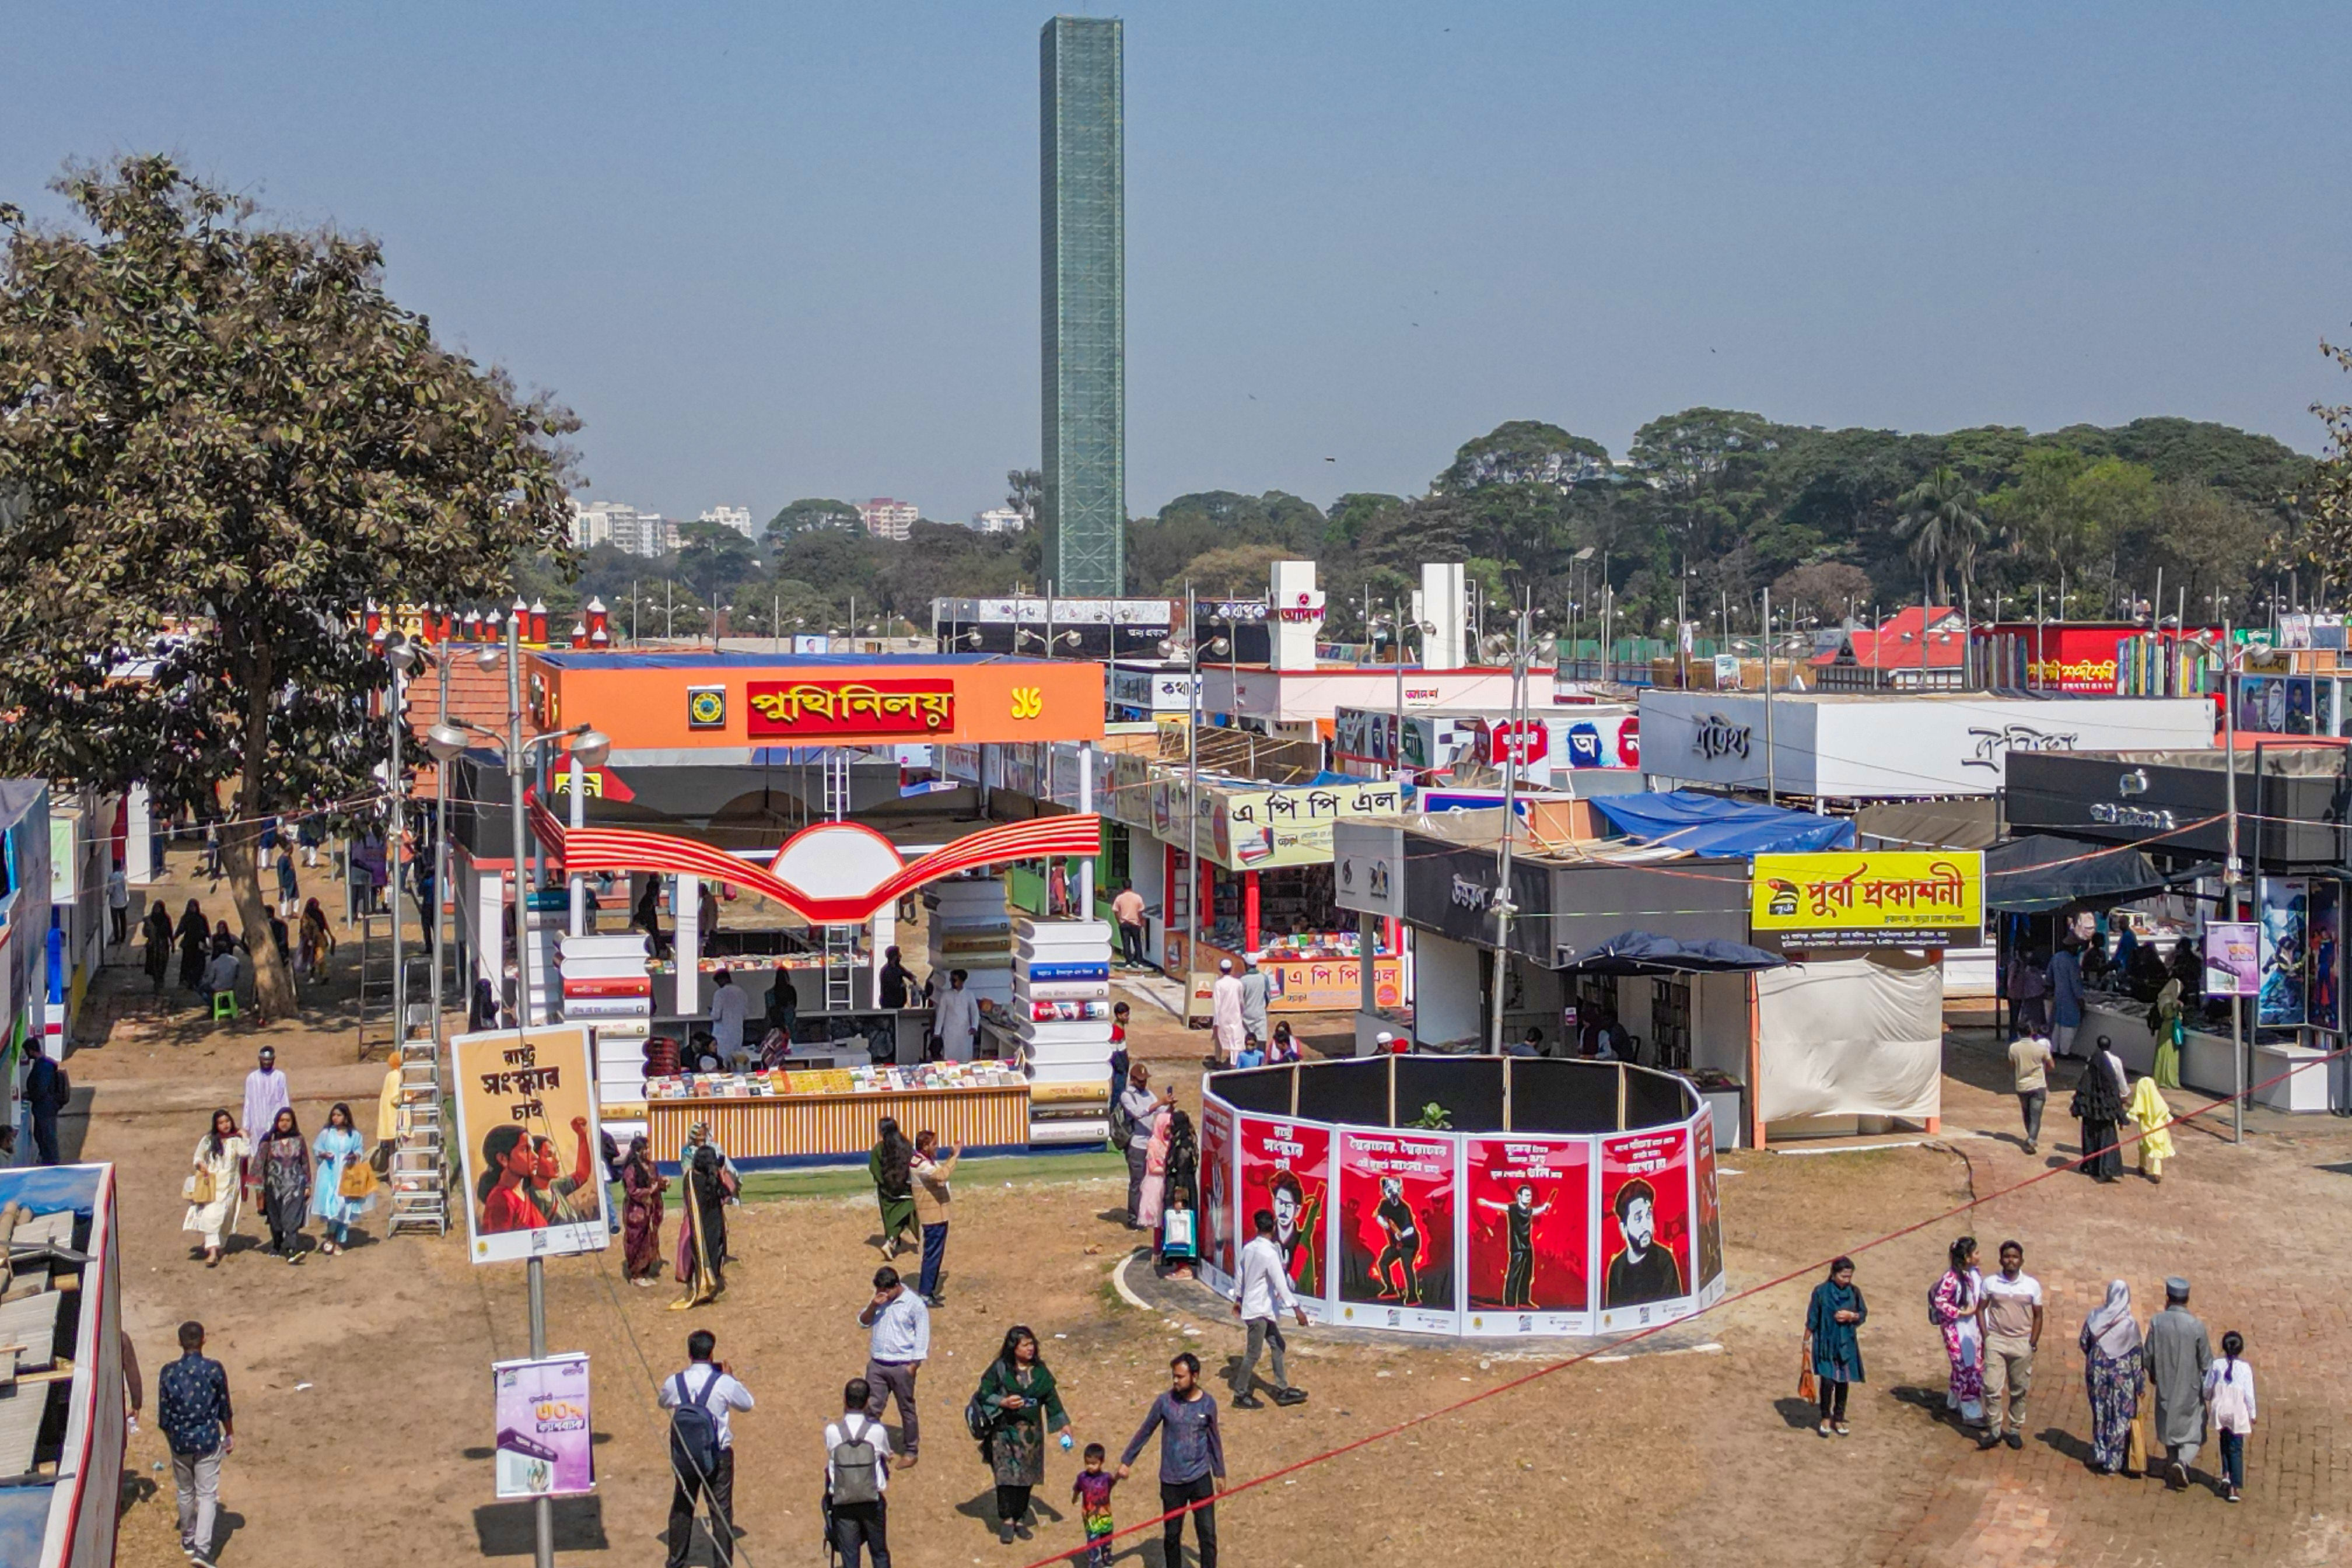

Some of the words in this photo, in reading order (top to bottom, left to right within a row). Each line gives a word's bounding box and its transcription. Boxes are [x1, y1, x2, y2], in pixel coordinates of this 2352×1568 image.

[1232, 804, 1254, 824] এ
[1265, 792, 1299, 823] পি
[1308, 791, 1341, 817] পি
[1352, 790, 1399, 813] এল
[1862, 860, 1966, 909] প্রকাশনী
[1289, 970, 1302, 985] এ
[1311, 964, 1332, 985] পি
[1339, 964, 1360, 985] পি
[503, 1044, 536, 1068] রাষ্ট্র
[481, 1066, 560, 1096] সংস্কার
[510, 1100, 543, 1121] চাই
